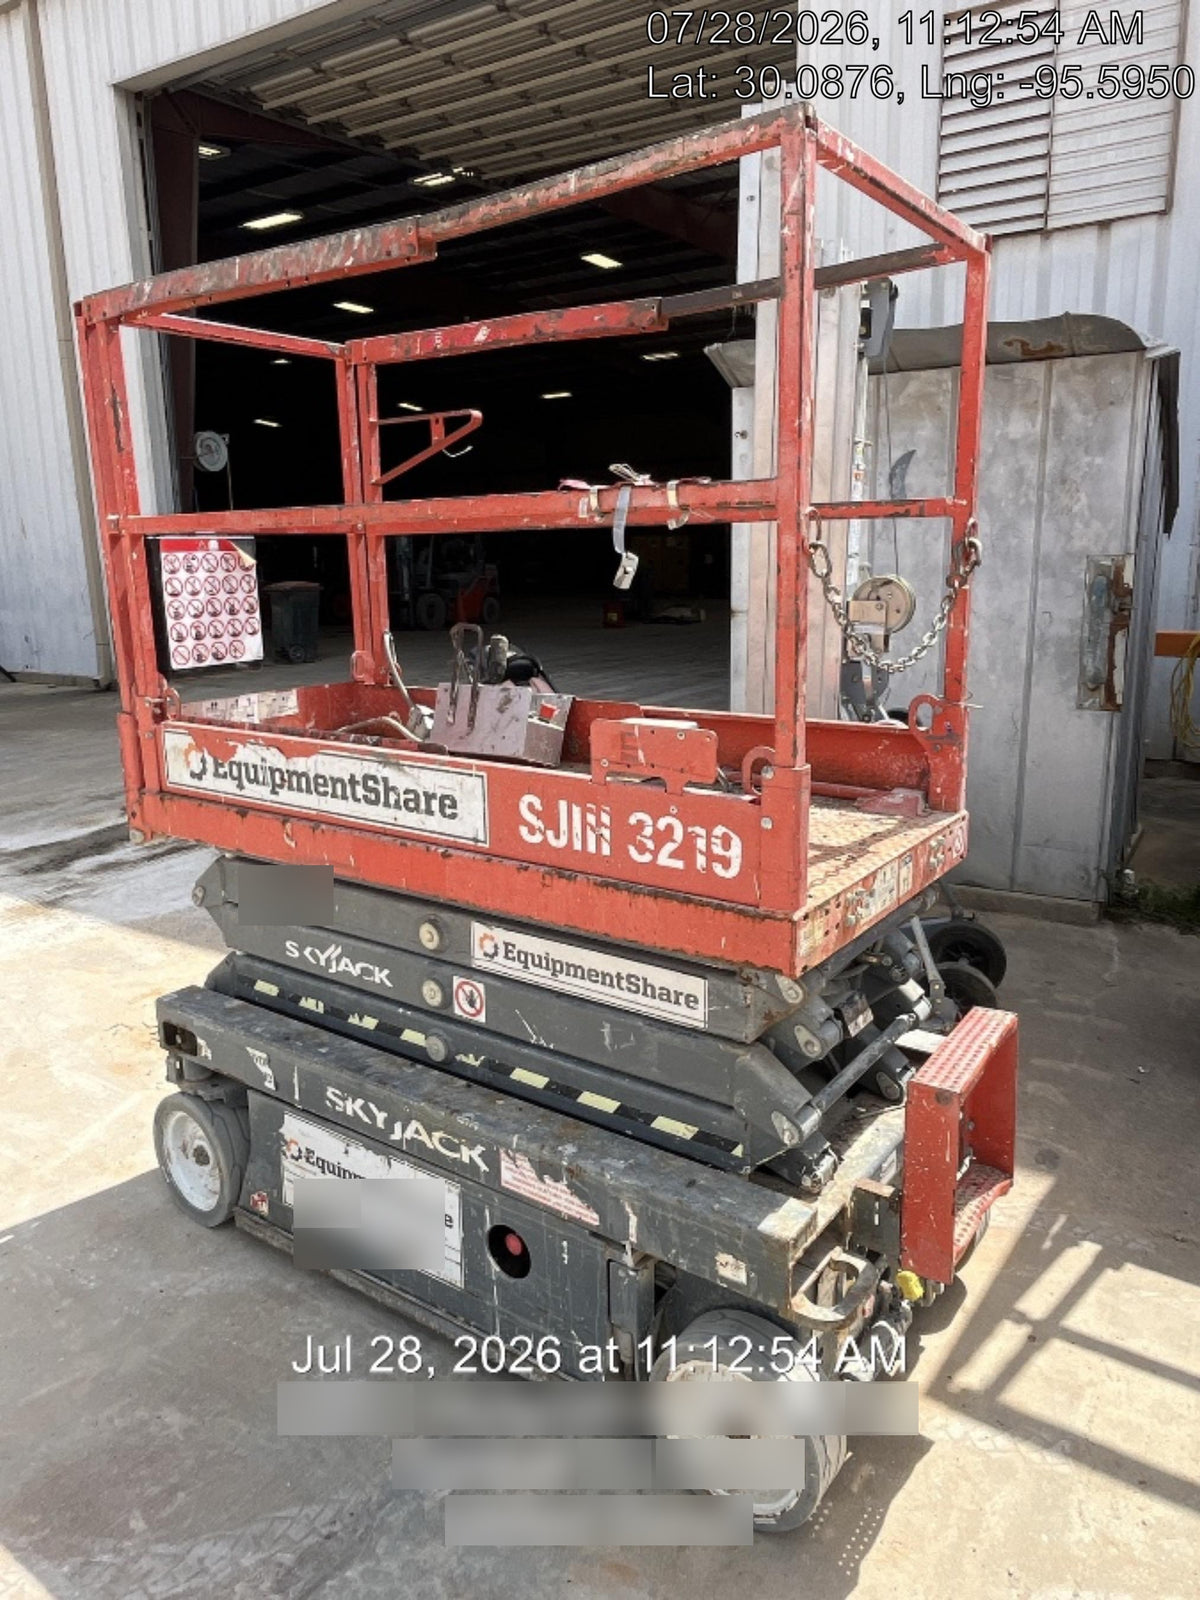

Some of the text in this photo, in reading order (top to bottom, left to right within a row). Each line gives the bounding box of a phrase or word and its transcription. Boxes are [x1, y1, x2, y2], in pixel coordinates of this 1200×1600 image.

[212, 756, 459, 821] EquipmentShare
[627, 810, 743, 880] 3219
[285, 939, 394, 989] SKYJACK
[502, 940, 700, 1010] EquipmentShare
[325, 1085, 490, 1172] SKYJACK
